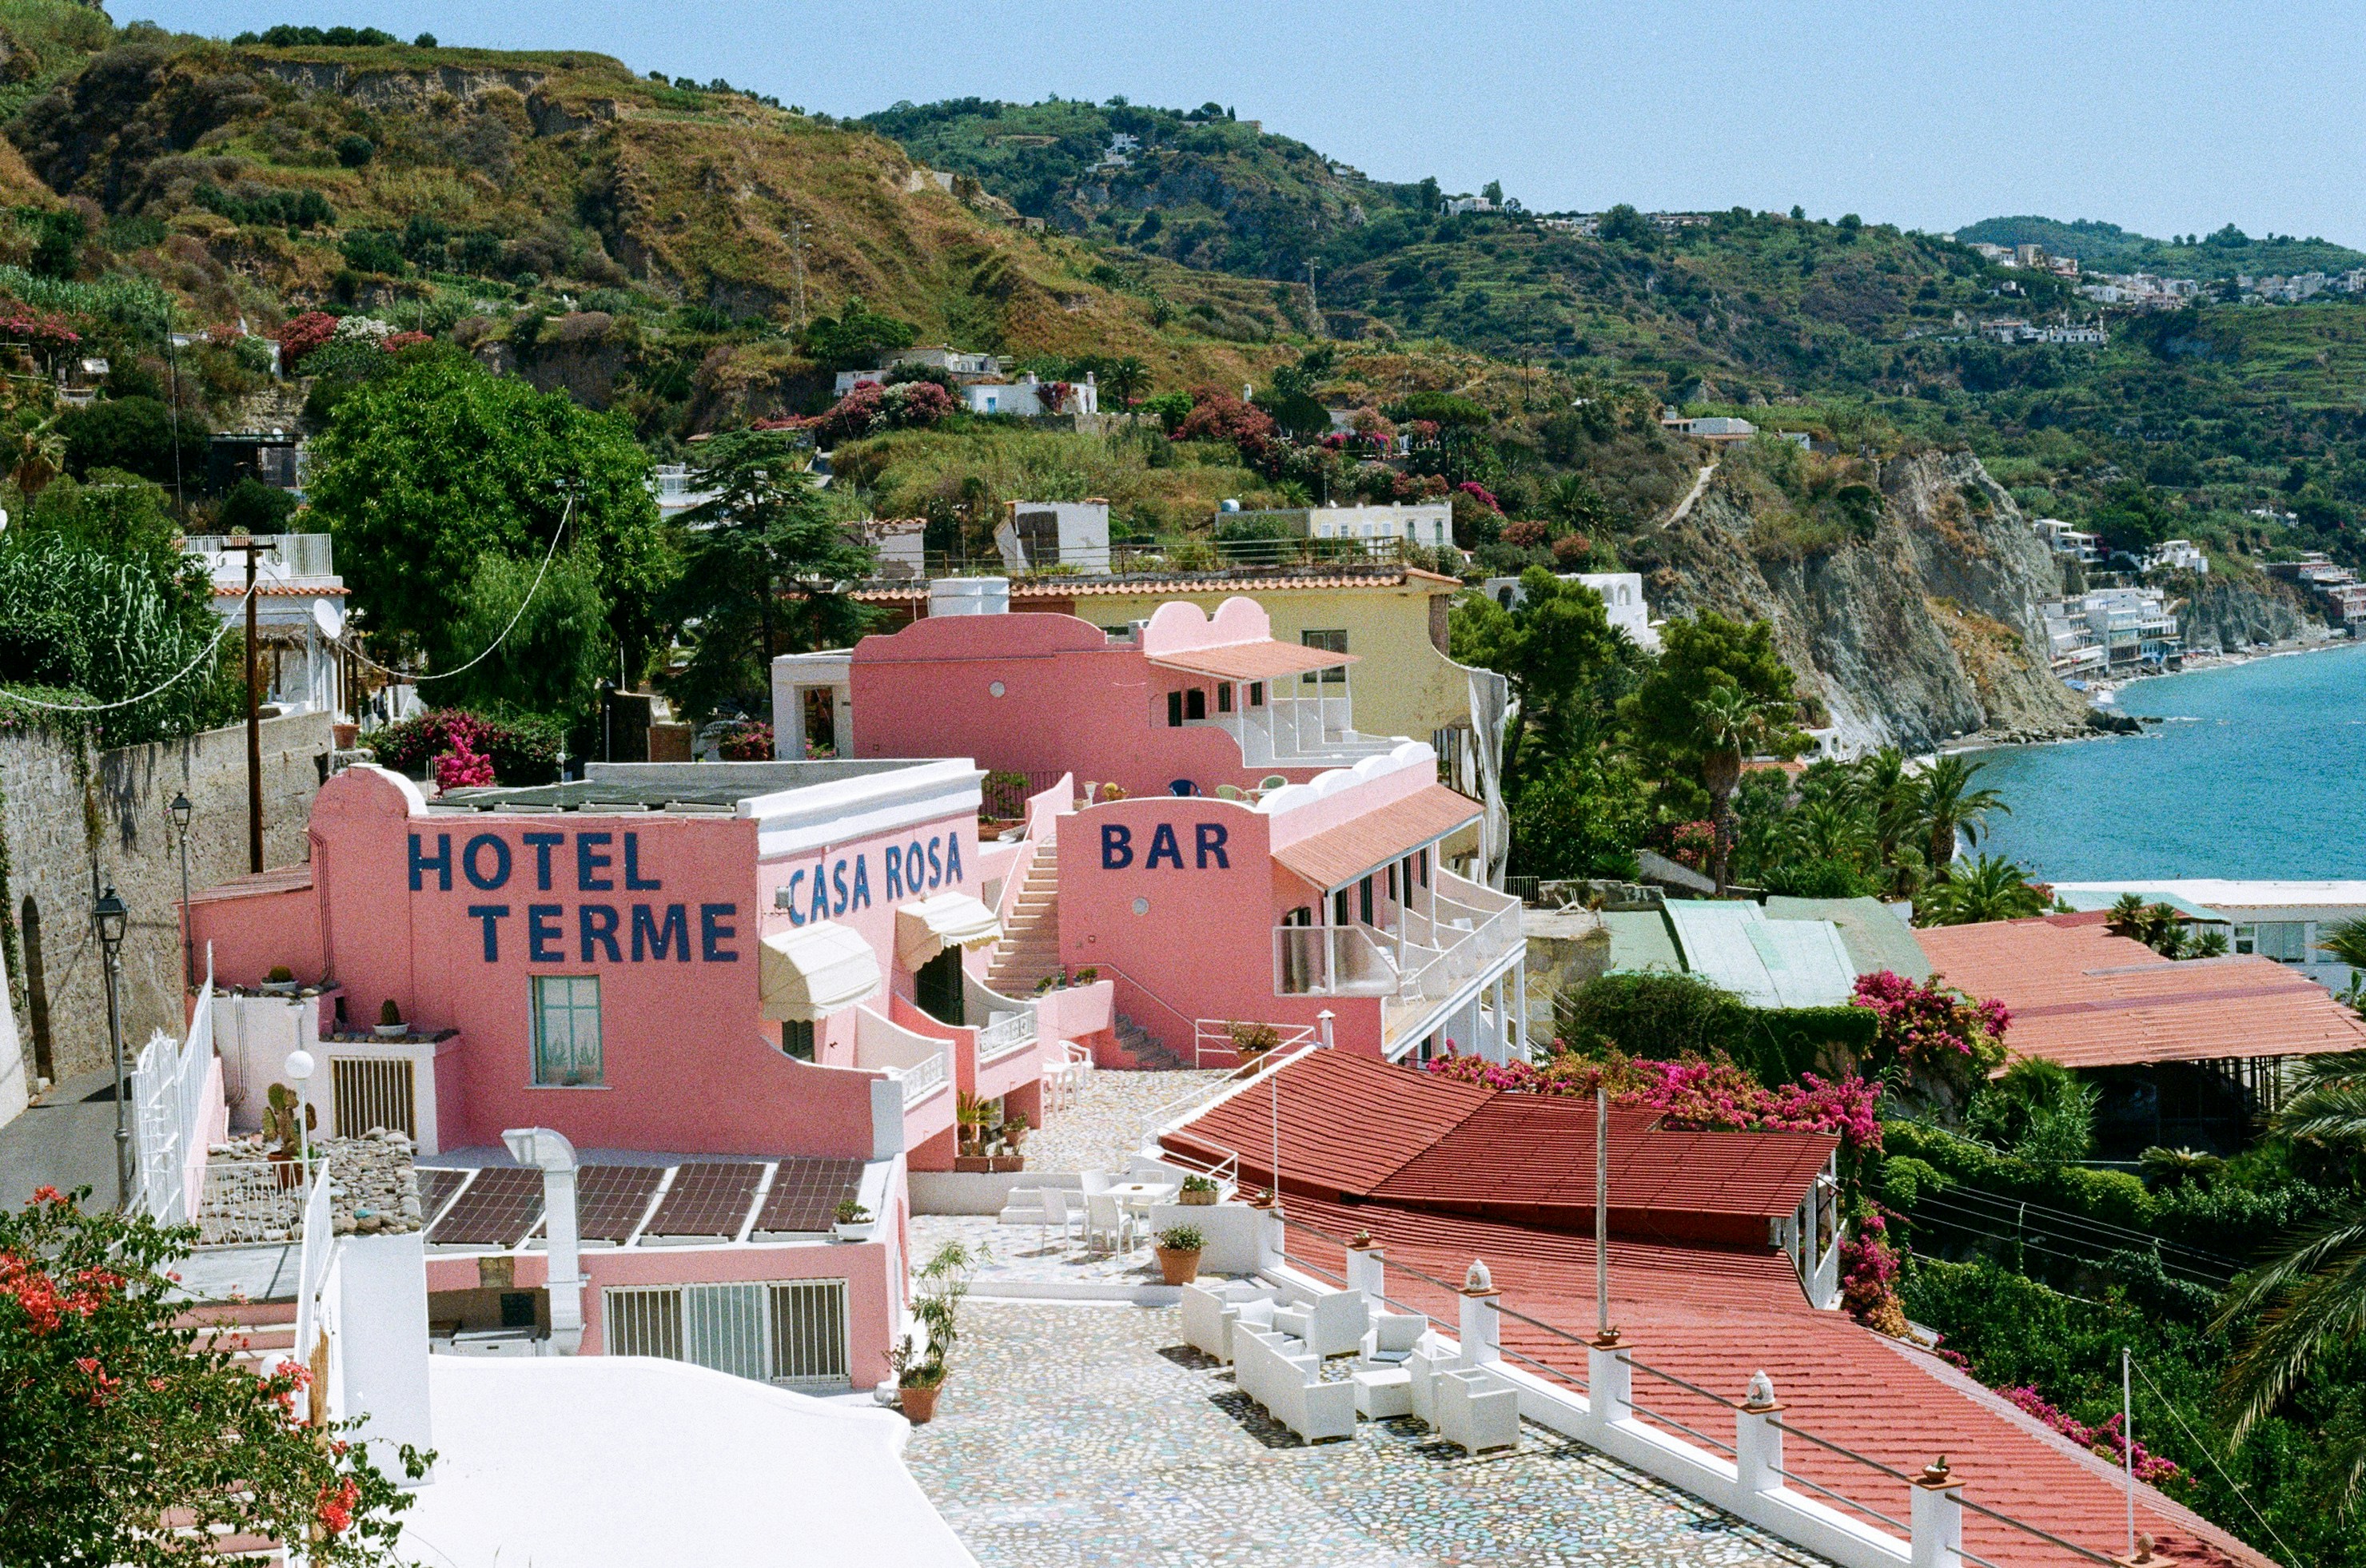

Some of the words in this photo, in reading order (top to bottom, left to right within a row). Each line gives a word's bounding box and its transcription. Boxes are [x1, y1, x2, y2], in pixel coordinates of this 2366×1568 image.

[408, 833, 661, 891] HOTEL
[1101, 823, 1230, 870] BAR
[789, 854, 870, 926] CASA
[886, 831, 962, 901] ROSA
[468, 903, 739, 963] TERME
